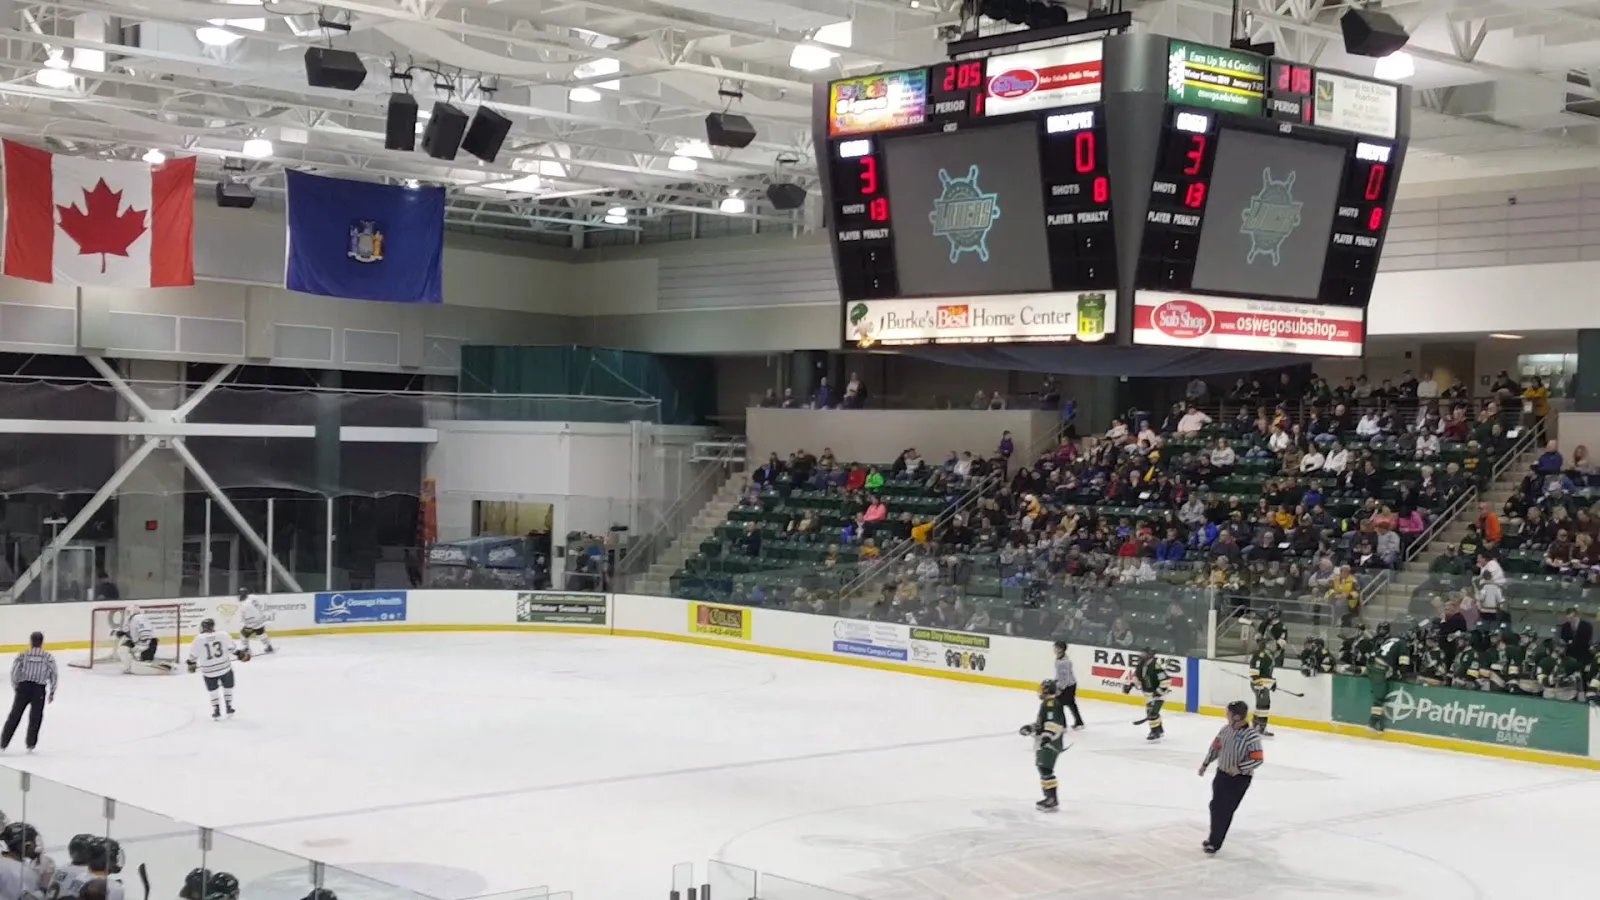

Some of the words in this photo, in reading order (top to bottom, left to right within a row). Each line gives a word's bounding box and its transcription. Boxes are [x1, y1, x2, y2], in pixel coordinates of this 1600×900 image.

[1189, 51, 1206, 63] Earn
[1207, 54, 1217, 66] Up
[1218, 56, 1226, 67] To
[1227, 59, 1233, 69] 4
[935, 100, 965, 113] PERIOD
[976, 93, 983, 114] 1
[1274, 100, 1299, 114] PERIOD
[1304, 101, 1311, 121] 1
[1075, 131, 1095, 173] 0
[1184, 135, 1206, 175] 3
[860, 156, 877, 194] 3
[1365, 164, 1386, 200] 0
[1052, 184, 1080, 195] SHOTS
[1093, 177, 1107, 203] 8
[1152, 181, 1177, 194] SHOTS
[1185, 182, 1206, 208] 13
[842, 203, 865, 214] SHOTS
[870, 198, 888, 221] 13
[1047, 213, 1074, 226] PLAYER
[1077, 210, 1109, 223] PENALTY
[1147, 211, 1171, 223] PLAYER
[1173, 213, 1200, 226] PENALTY
[1338, 206, 1359, 218] SHOTS
[839, 231, 860, 241] PLAYER
[863, 228, 889, 239] PENALTY
[1333, 233, 1353, 245] PLAYER
[1355, 235, 1377, 247] PENALTY
[887, 310, 934, 330] Burke's
[973, 308, 1015, 327] Home
[1020, 306, 1071, 326] Center
[1160, 310, 1179, 327] Sub
[1180, 312, 1206, 333] Shop
[347, 598, 376, 607] Oswego
[376, 597, 402, 606] Health
[531, 604, 557, 613] Winter
[559, 604, 587, 613] Session
[588, 605, 606, 614] 2019
[912, 628, 931, 638] Game
[931, 630, 943, 642] Day
[204, 641, 223, 660] 13
[1094, 650, 1181, 673] RAB'S
[1416, 697, 1538, 735] PathFinder
[1496, 731, 1529, 746] BANK
